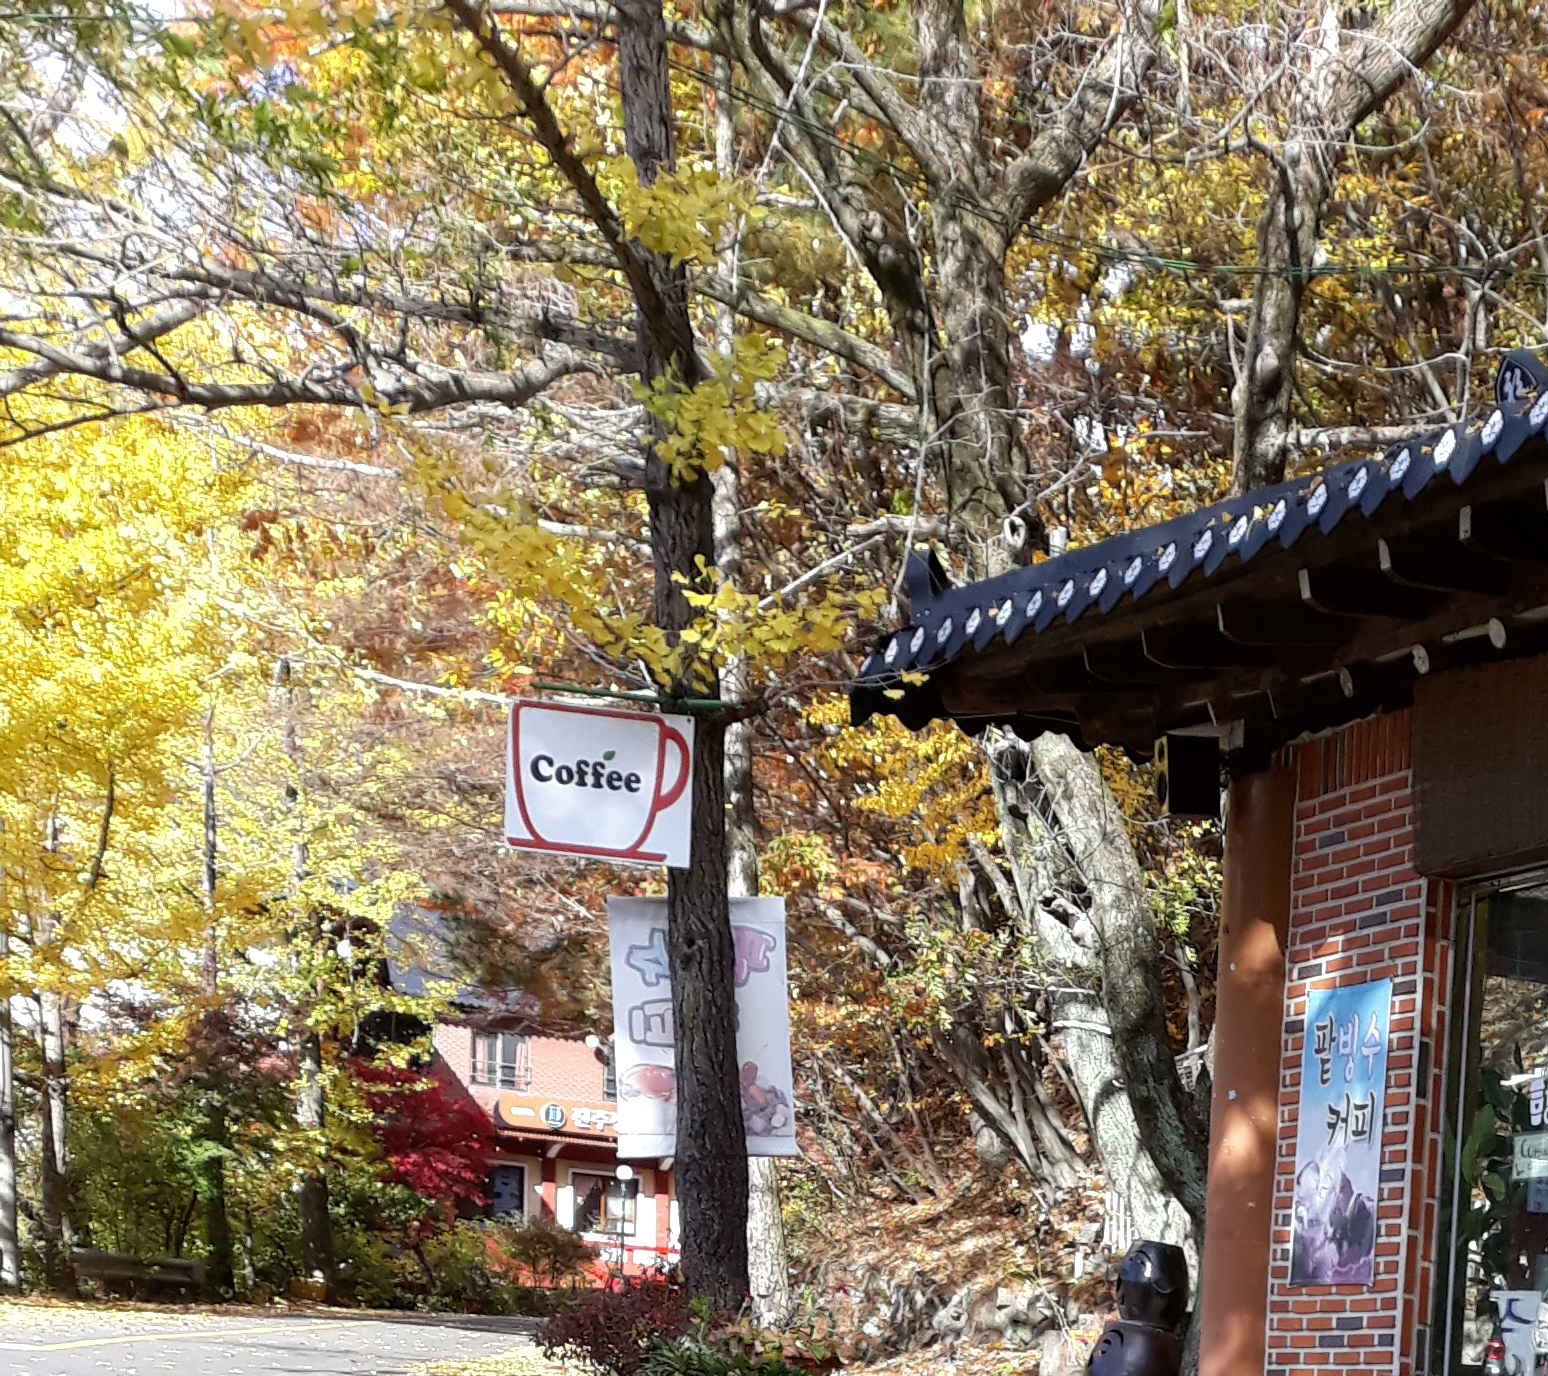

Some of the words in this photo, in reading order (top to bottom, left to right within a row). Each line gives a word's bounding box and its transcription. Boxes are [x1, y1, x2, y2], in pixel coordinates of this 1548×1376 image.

[530, 754, 641, 793] Coffee
[1314, 1012, 1382, 1085] 팥빙수
[1326, 1092, 1375, 1147] 커피
